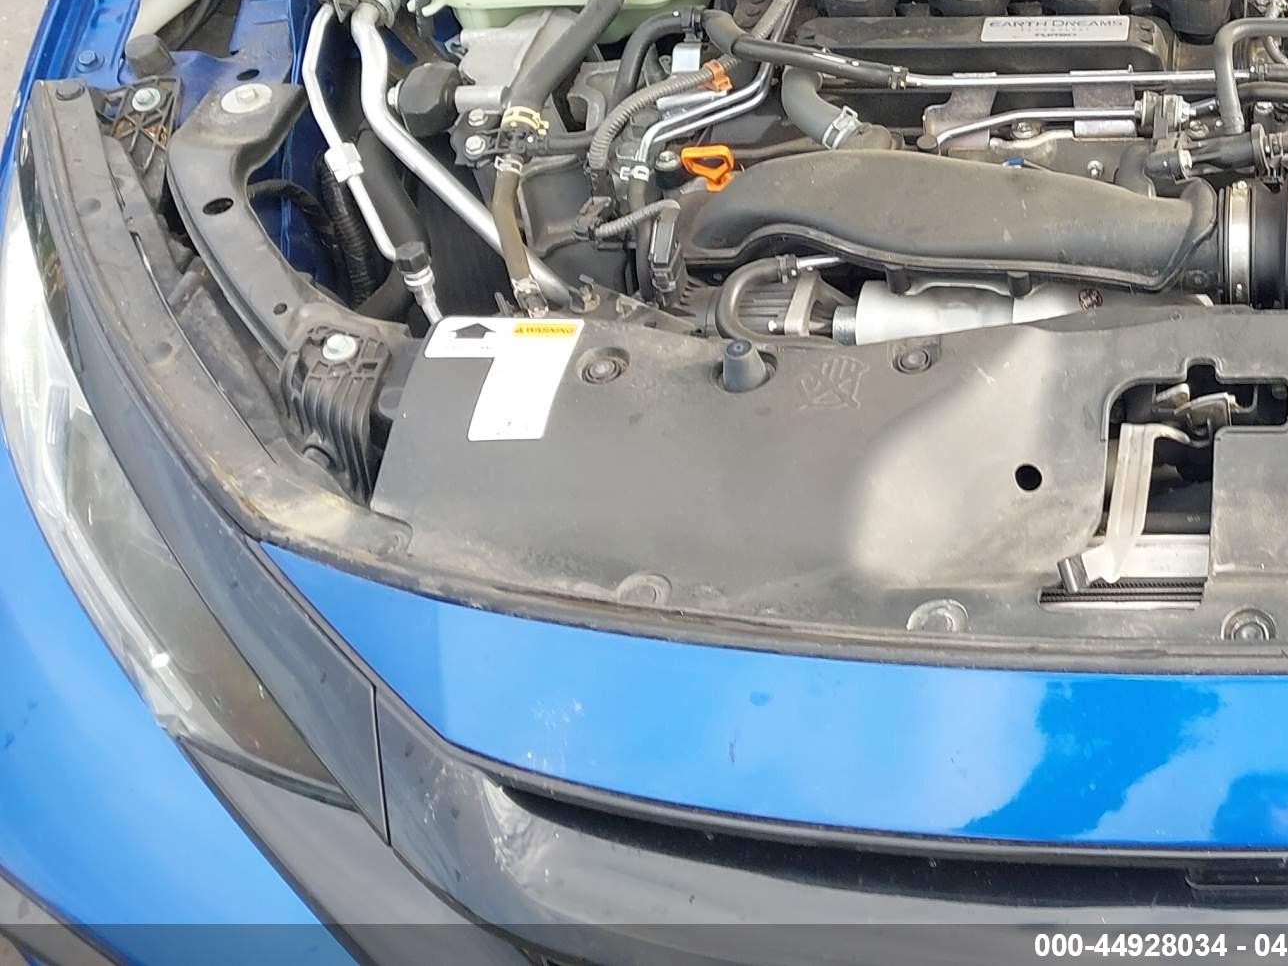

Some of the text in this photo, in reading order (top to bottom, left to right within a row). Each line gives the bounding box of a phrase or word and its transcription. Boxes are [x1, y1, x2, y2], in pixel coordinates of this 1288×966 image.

[989, 18, 1123, 27] EARTH DREAMS
[526, 326, 576, 334] WARNING
